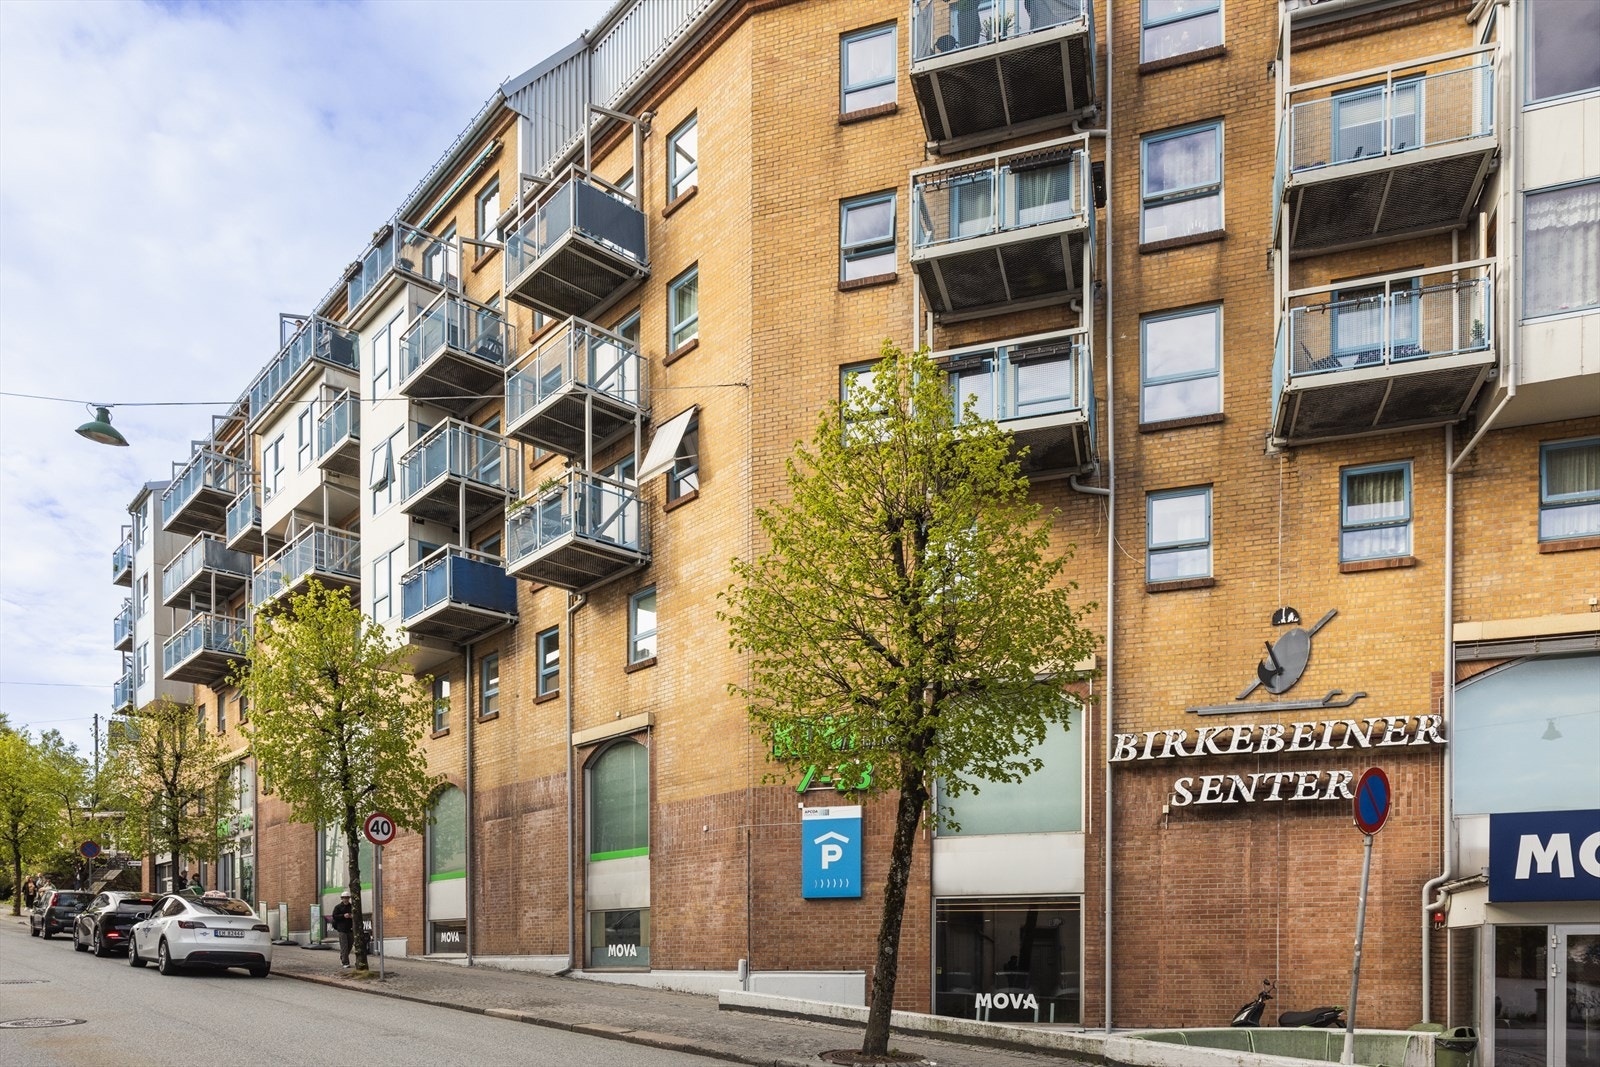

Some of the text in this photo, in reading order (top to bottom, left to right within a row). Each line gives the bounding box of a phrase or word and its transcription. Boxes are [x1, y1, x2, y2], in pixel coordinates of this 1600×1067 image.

[1108, 714, 1449, 763] BIRKEBEINER
[1171, 770, 1356, 807] SENTER
[370, 820, 391, 835] 40
[821, 844, 843, 870] P
[440, 931, 460, 943] MOVA
[608, 943, 638, 957] MOVA
[974, 992, 1039, 1009] MOVA
